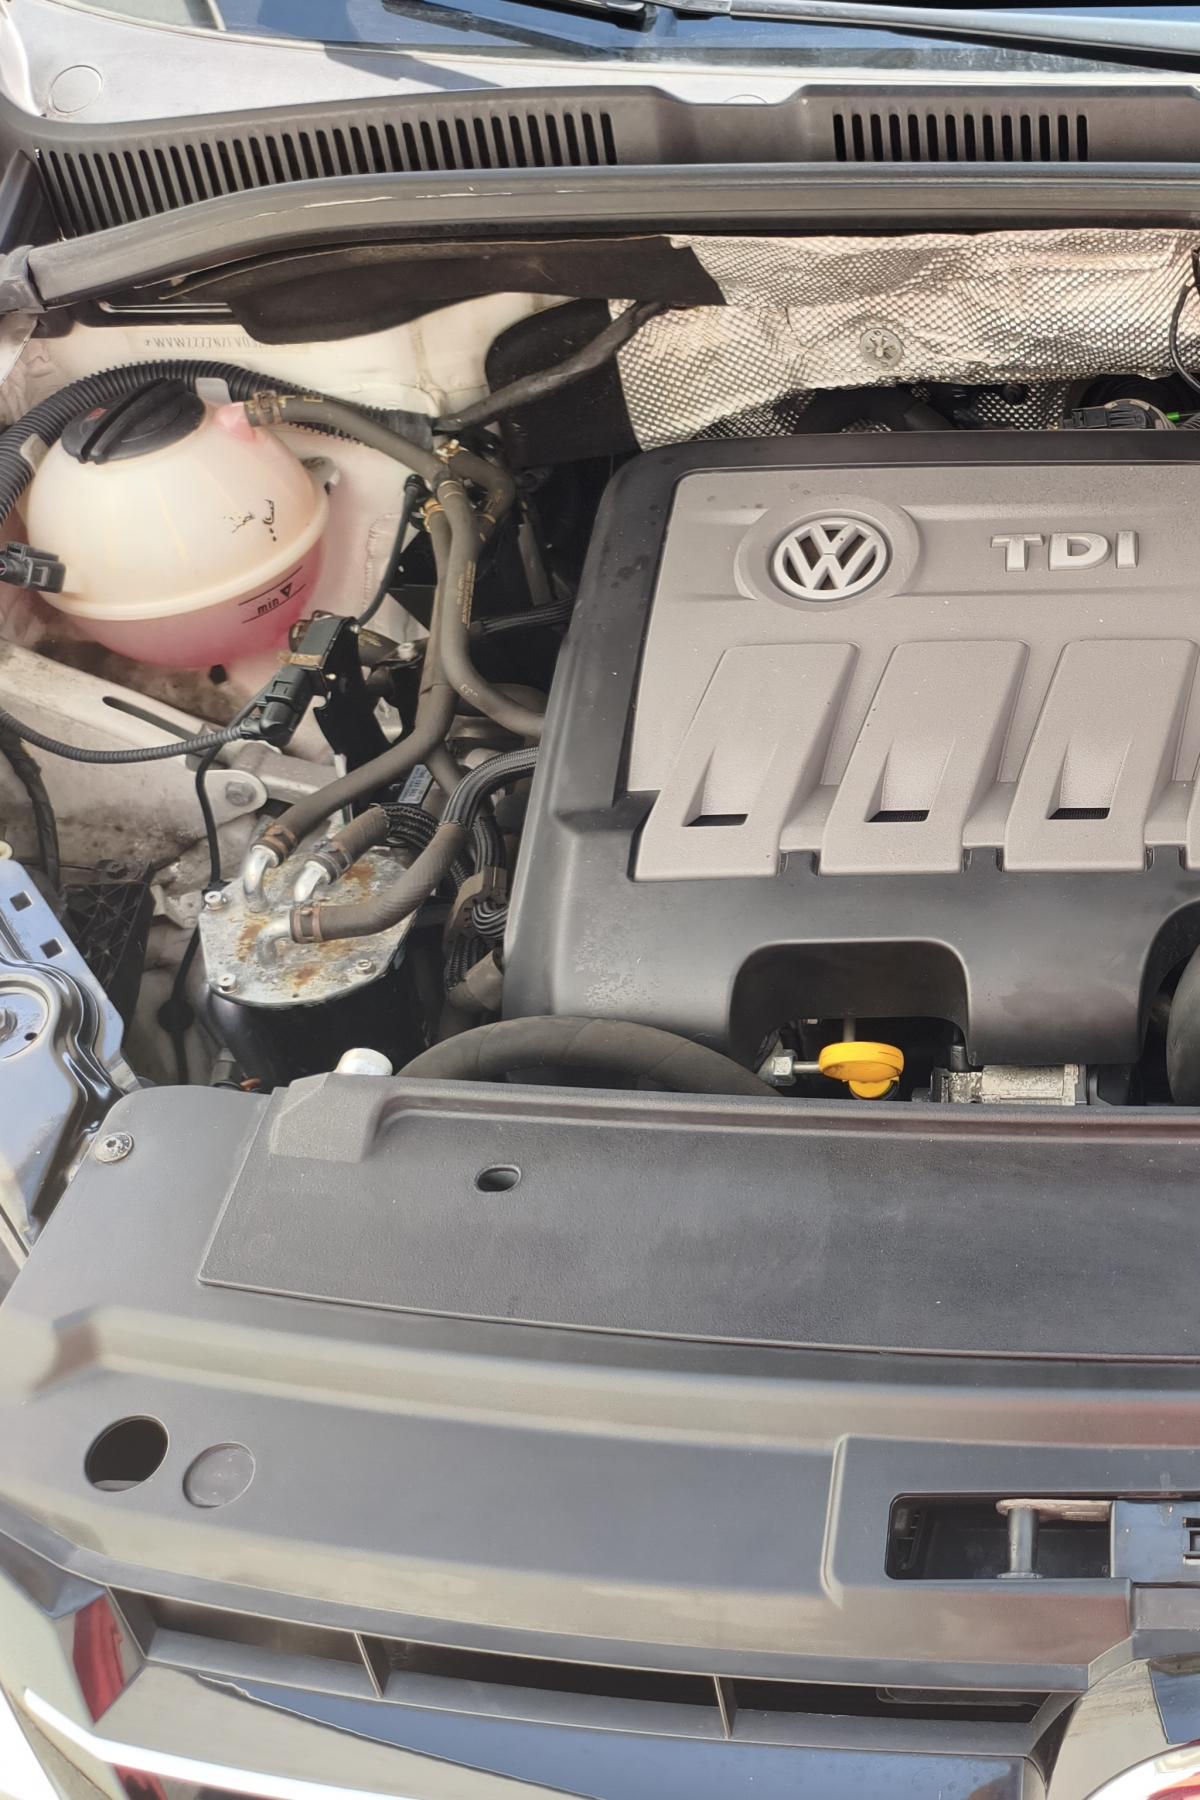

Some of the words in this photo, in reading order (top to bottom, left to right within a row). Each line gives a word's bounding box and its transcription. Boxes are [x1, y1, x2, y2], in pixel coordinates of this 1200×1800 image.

[773, 517, 888, 601] VW
[991, 530, 1139, 572] TDI
[256, 597, 280, 615] min
